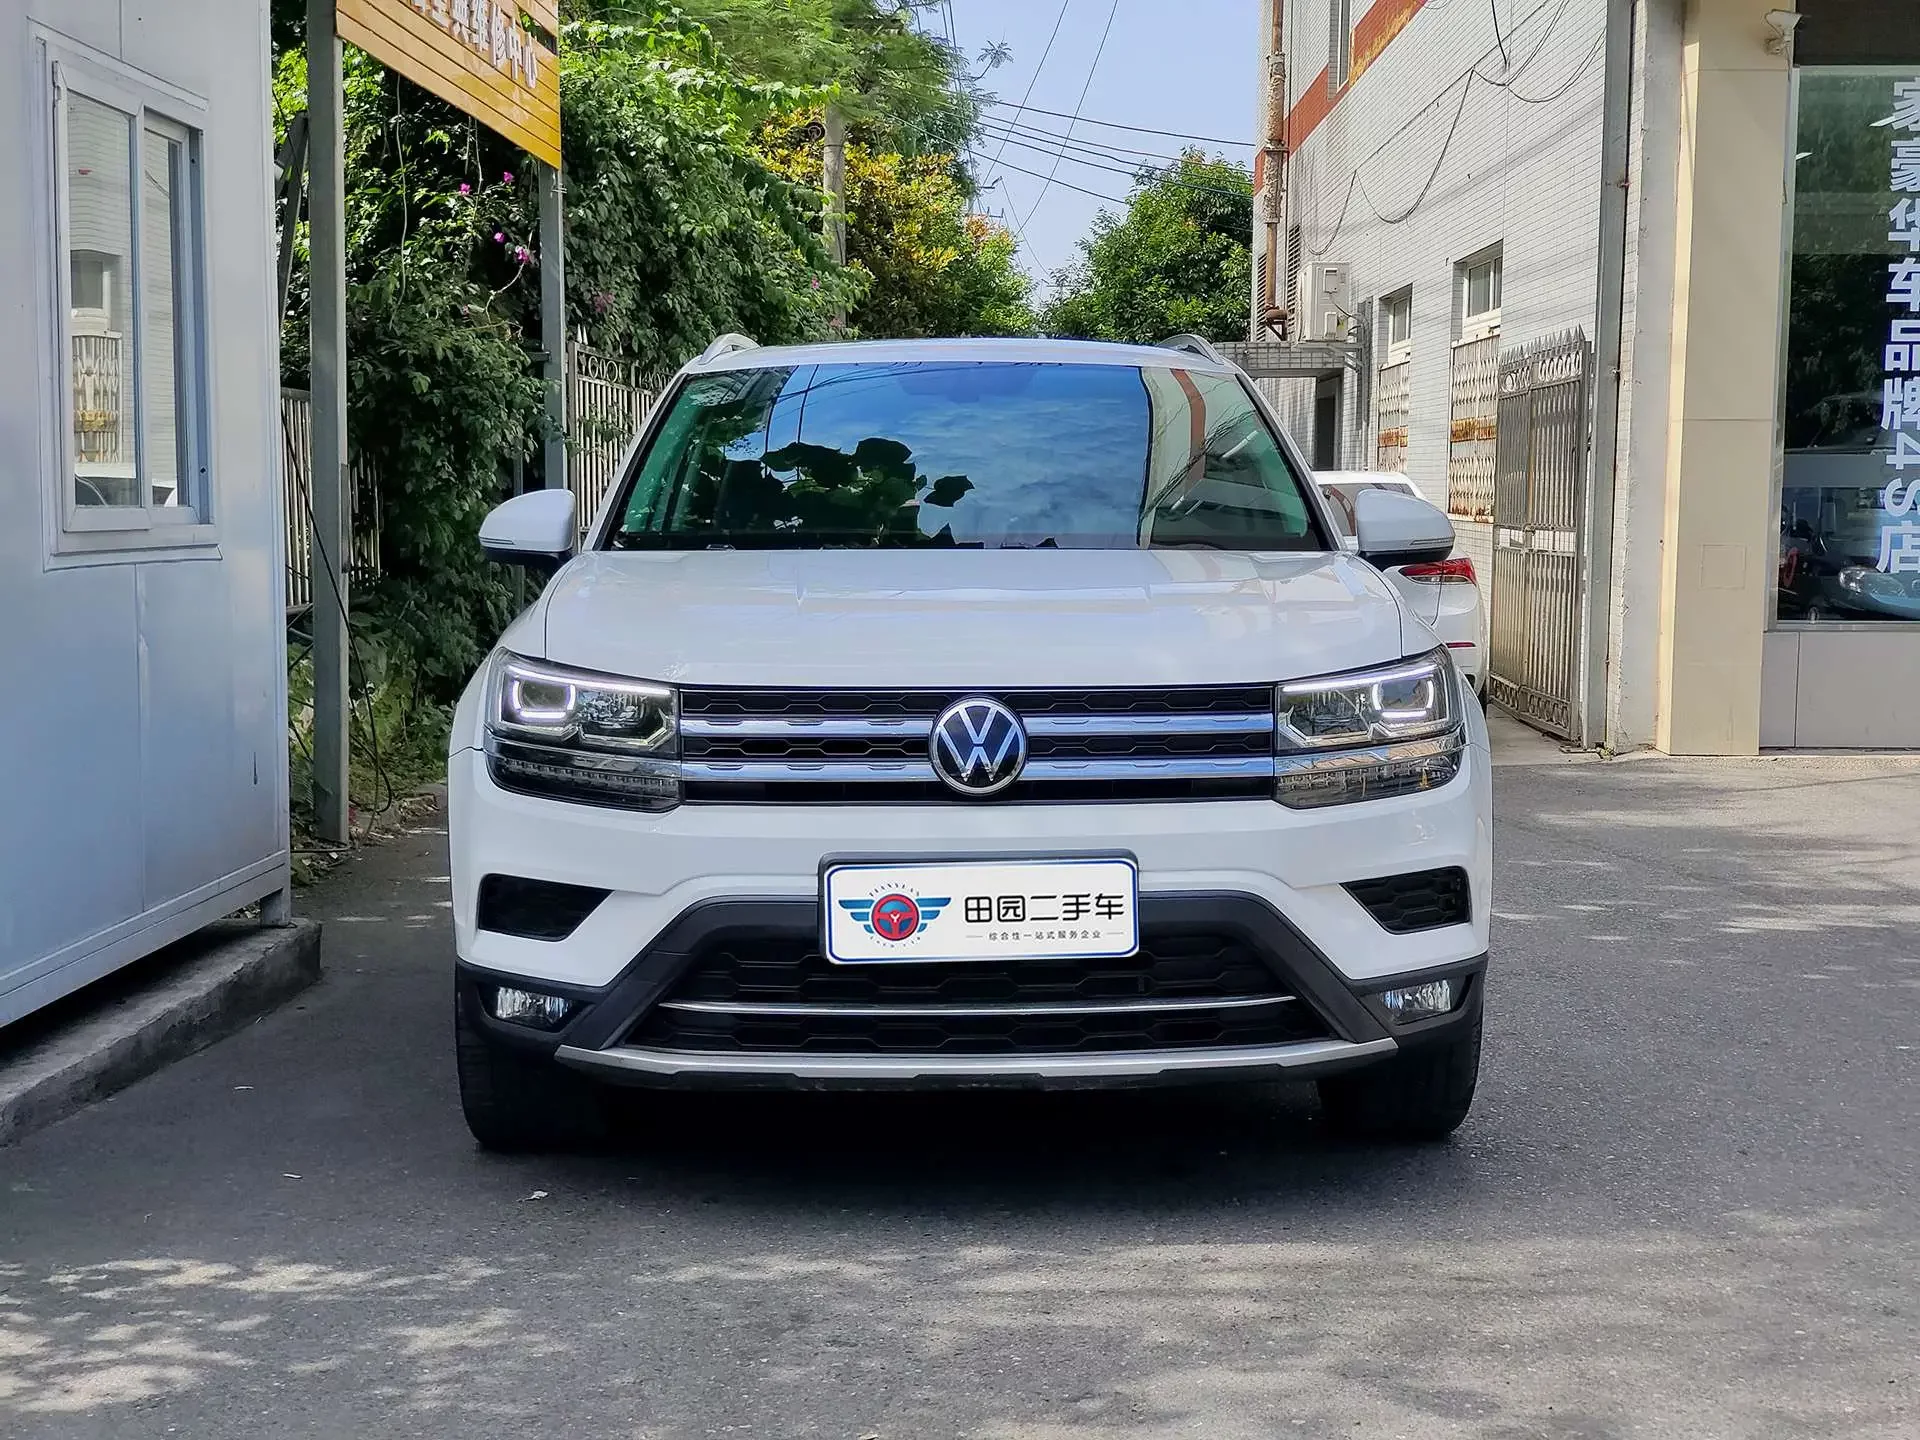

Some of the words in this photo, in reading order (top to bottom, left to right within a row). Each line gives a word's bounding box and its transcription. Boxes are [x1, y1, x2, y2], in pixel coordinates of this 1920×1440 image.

[938, 704, 1018, 783] VW
[964, 893, 1124, 923] 田园二手车
[988, 929, 1101, 941] 综合性一站式服务企业
